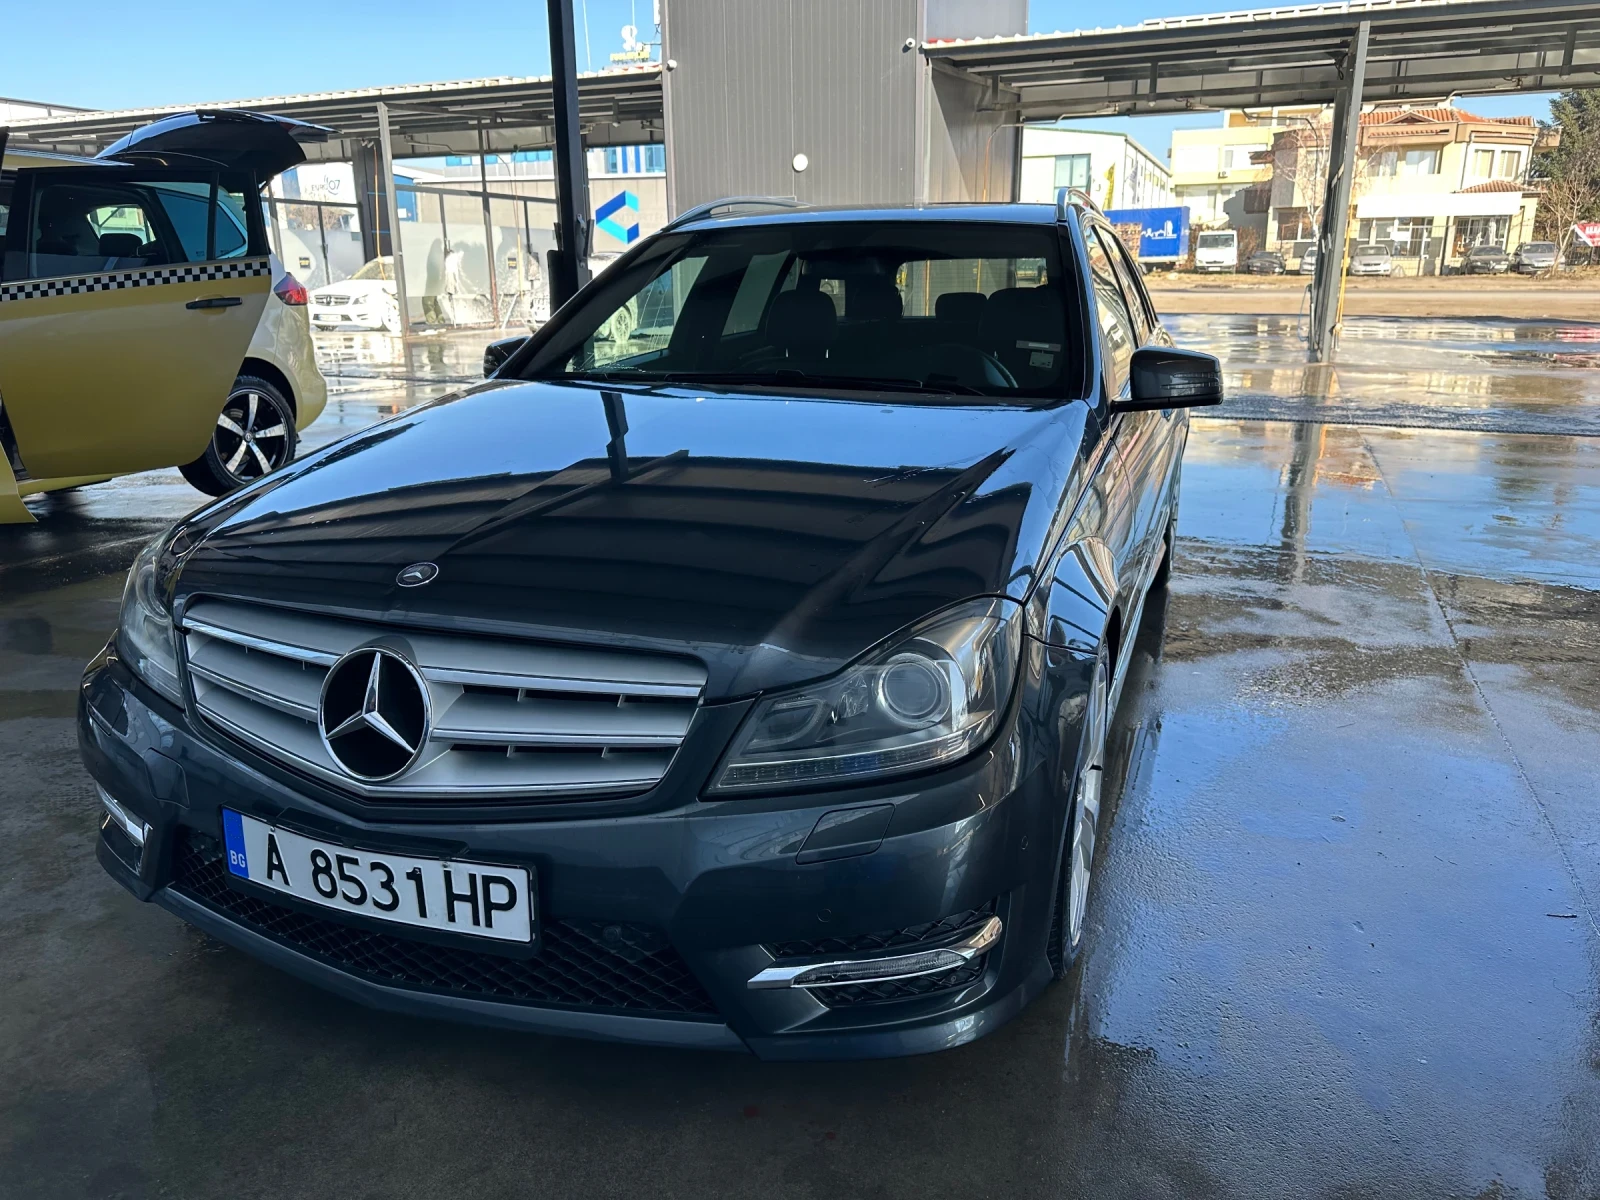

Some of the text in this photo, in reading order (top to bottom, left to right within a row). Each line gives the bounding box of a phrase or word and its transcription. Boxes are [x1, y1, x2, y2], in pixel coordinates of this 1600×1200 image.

[230, 850, 246, 868] BG
[267, 833, 518, 928] A 8531 HP
